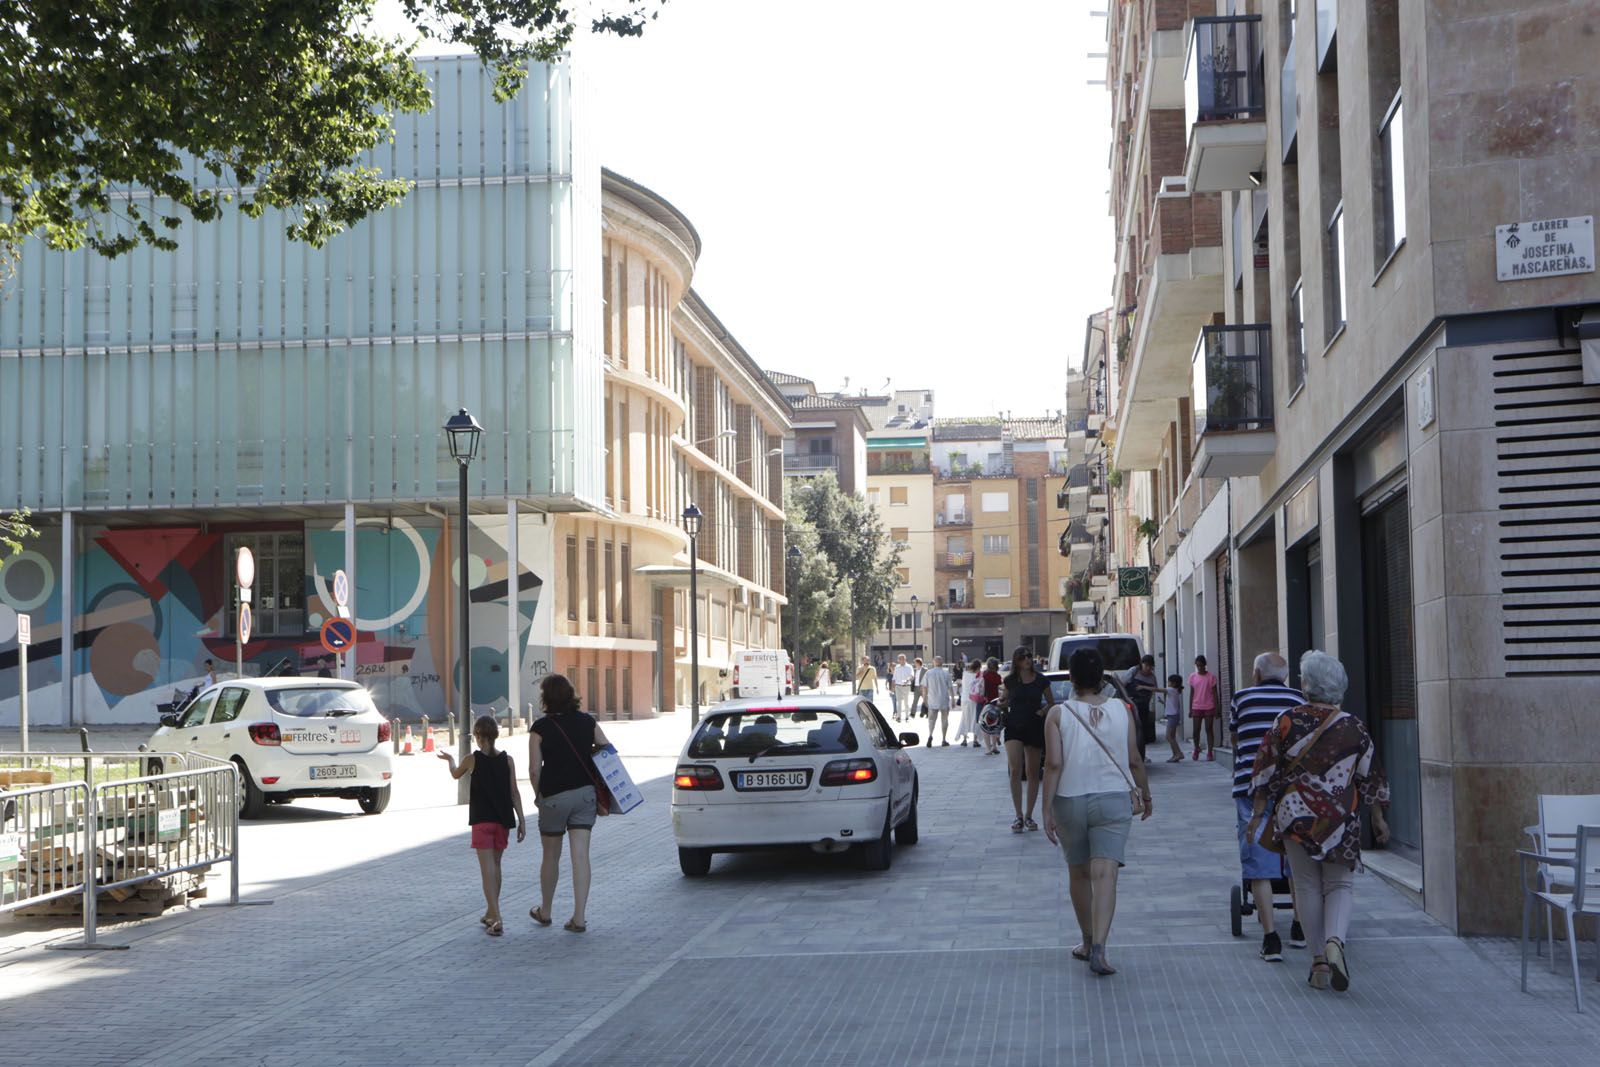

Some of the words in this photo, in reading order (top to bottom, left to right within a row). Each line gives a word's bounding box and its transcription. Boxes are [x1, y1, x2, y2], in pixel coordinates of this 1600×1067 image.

[1532, 220, 1568, 232] CARRER
[1545, 233, 1556, 242] DE
[1523, 243, 1574, 259] JOSEFINA
[1512, 255, 1586, 276] MASCAREÑAS
[293, 732, 328, 742] FERtres
[316, 768, 337, 777] 2609
[339, 766, 354, 775] JYC
